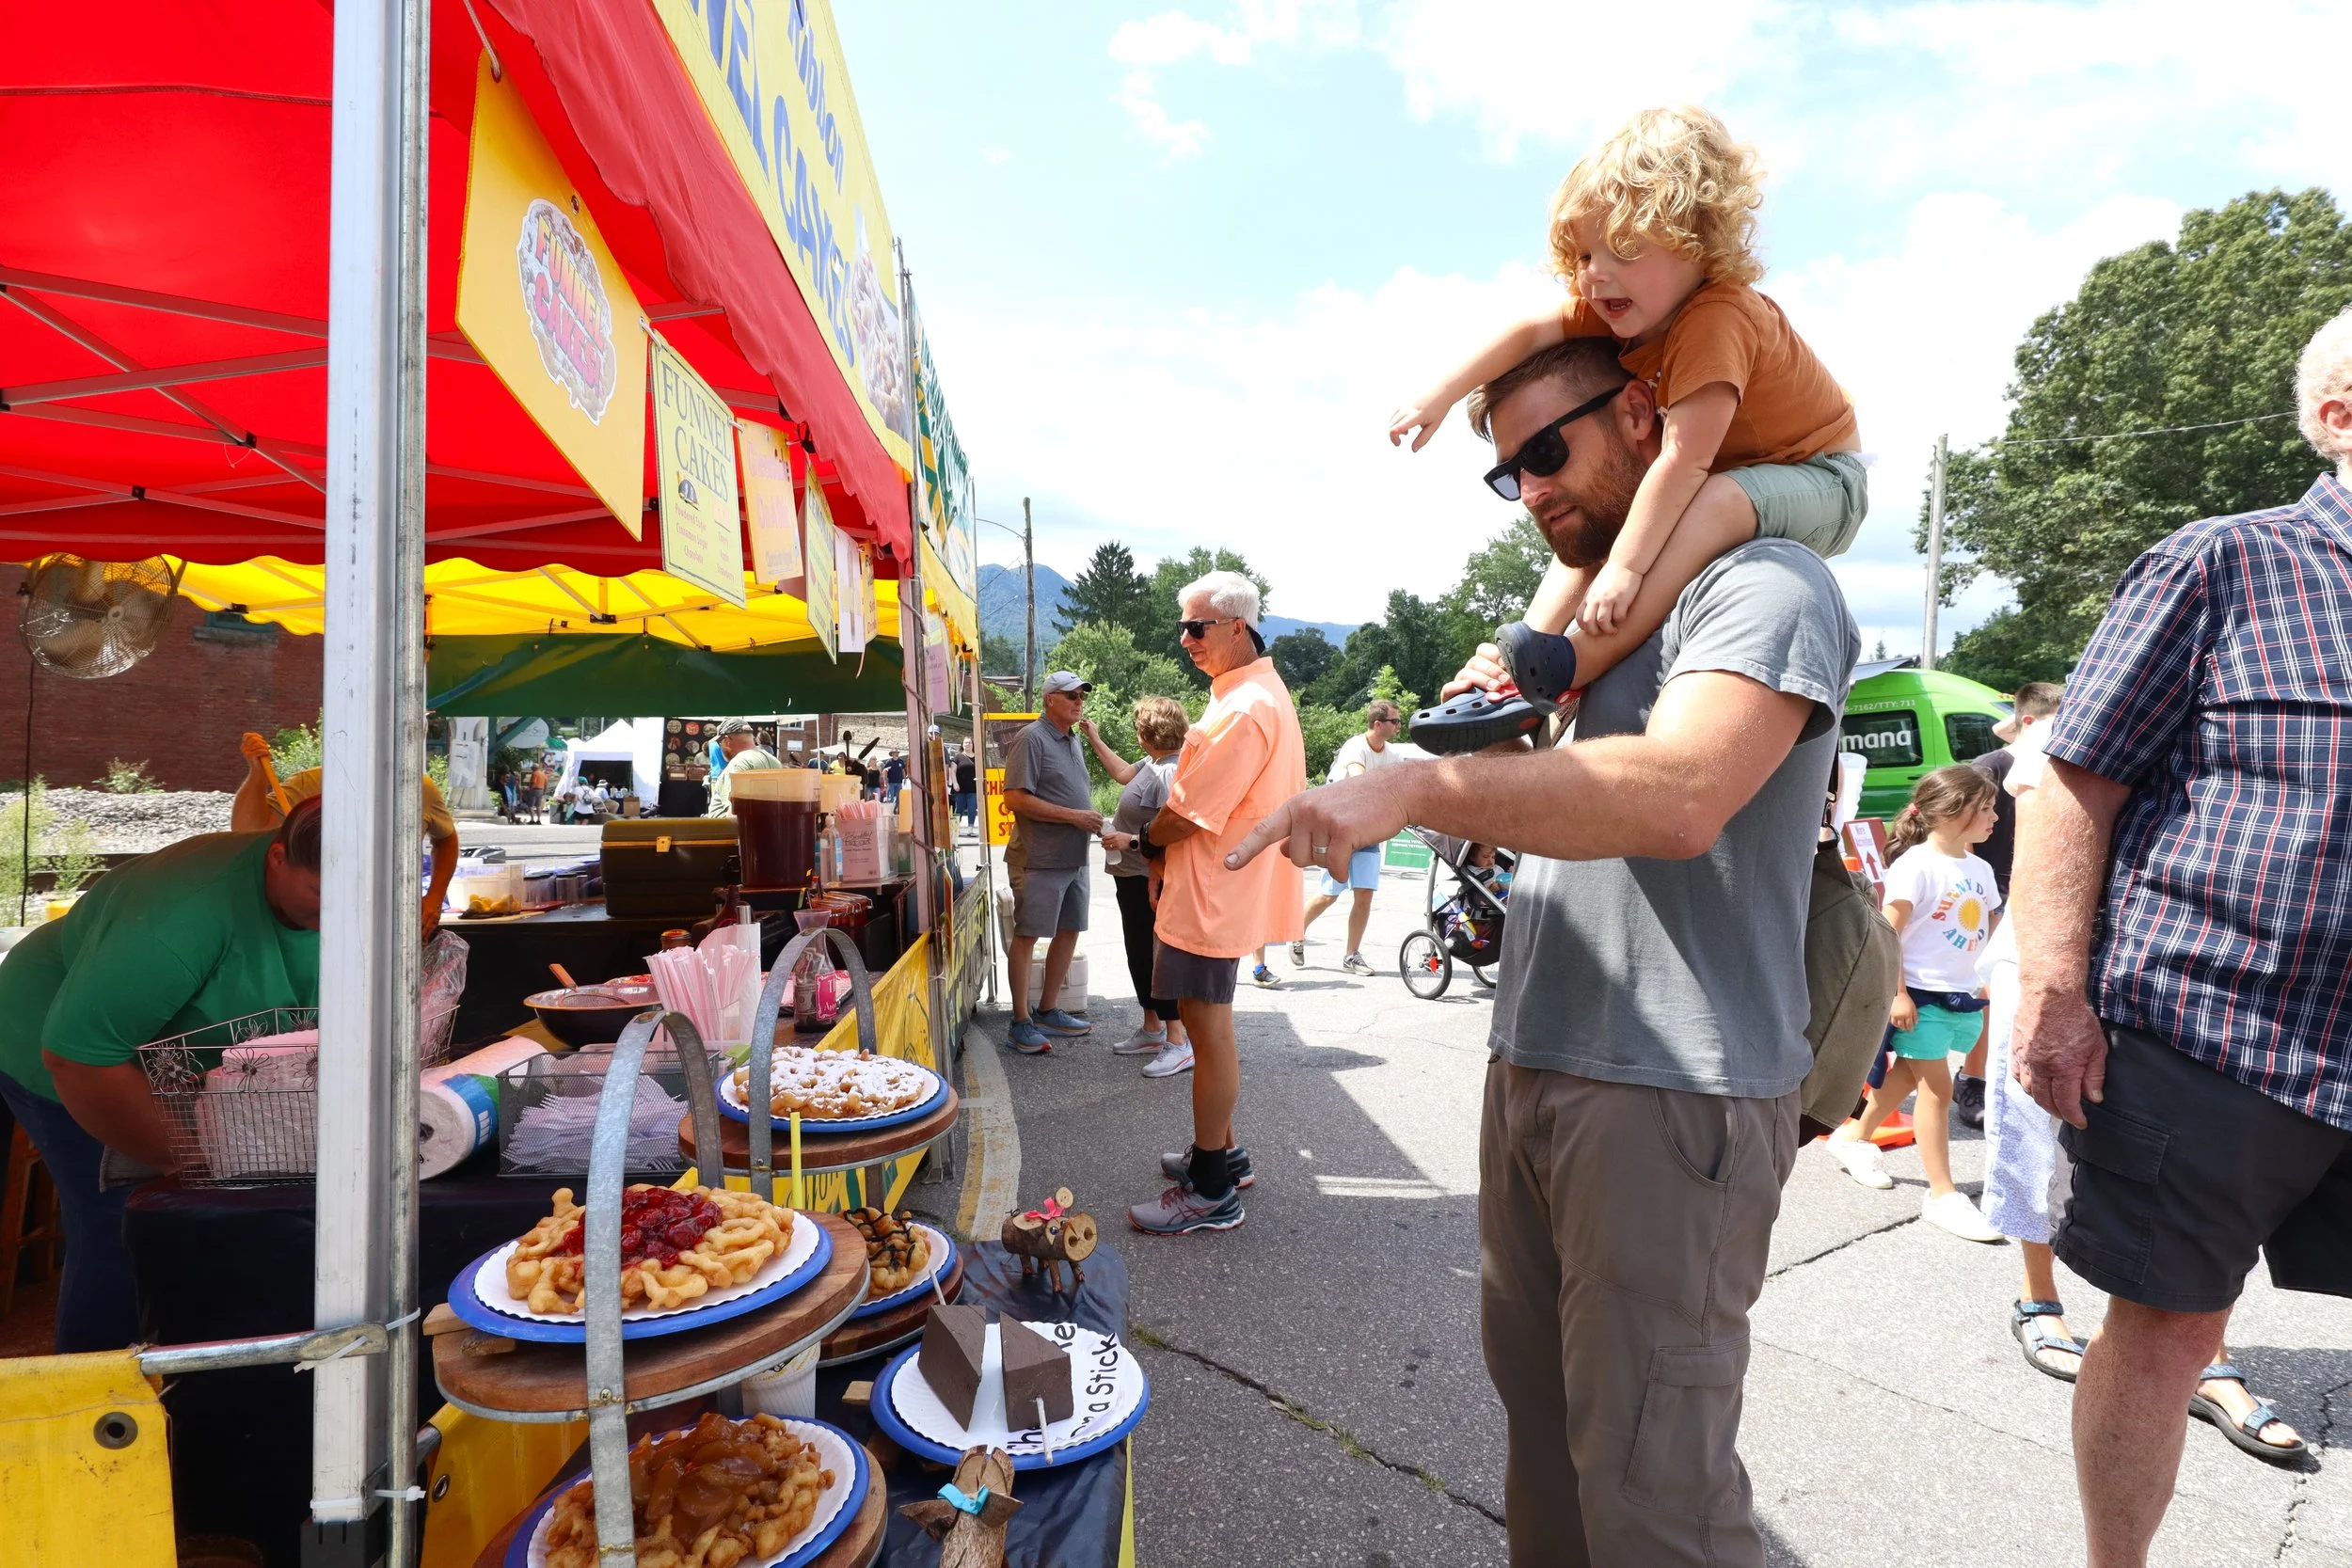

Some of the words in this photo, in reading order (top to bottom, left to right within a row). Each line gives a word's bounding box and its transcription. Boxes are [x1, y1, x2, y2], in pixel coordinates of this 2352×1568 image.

[773, 94, 855, 368] CAKES
[535, 214, 604, 356] FUNNEL
[661, 359, 731, 463] FUNNEL
[675, 425, 729, 503] CAKES
[1900, 699, 1915, 707] 711
[1841, 730, 1912, 753] mana
[1942, 927, 1985, 952] AHED
[1086, 1331, 1119, 1396] Stick
[1088, 1402, 1111, 1413] a
